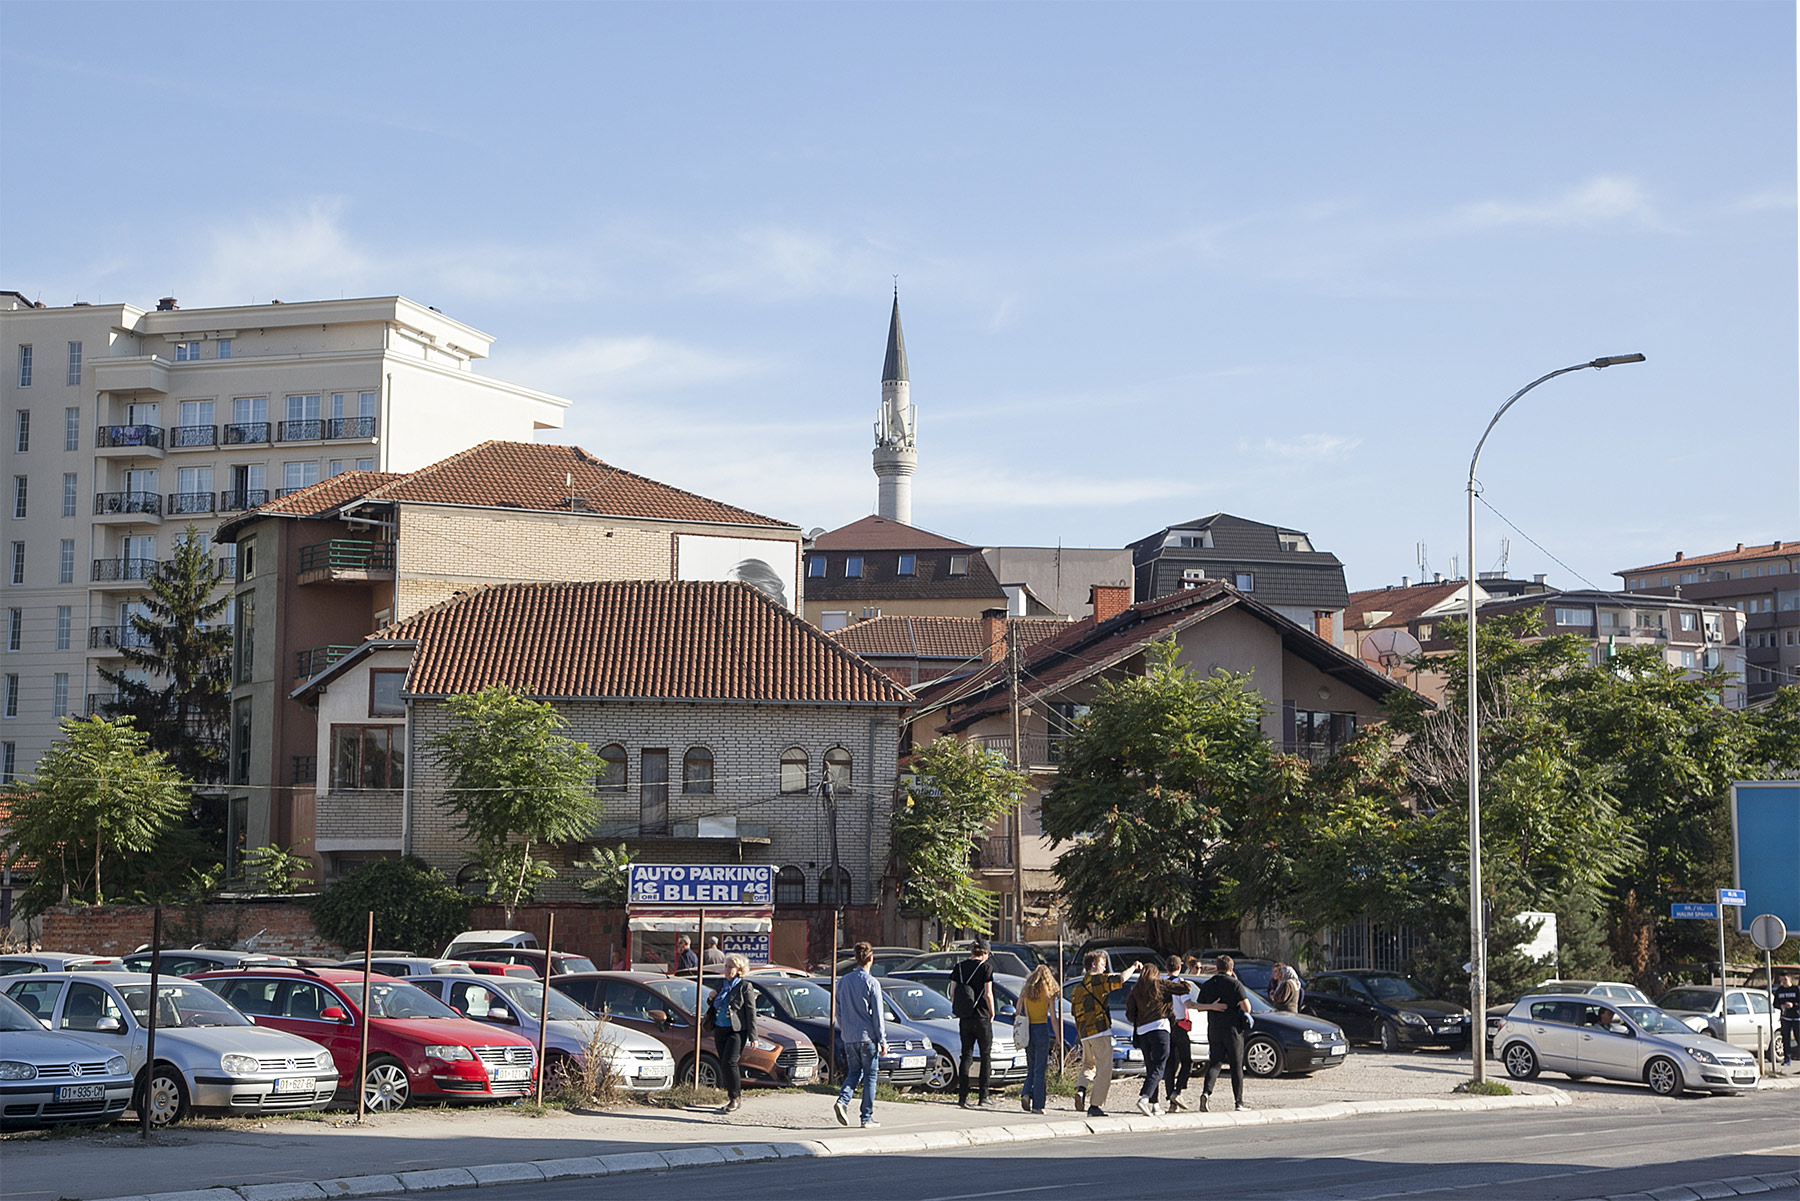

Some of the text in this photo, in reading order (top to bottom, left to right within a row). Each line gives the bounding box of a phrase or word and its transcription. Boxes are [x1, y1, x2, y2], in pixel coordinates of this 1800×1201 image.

[635, 867, 769, 880] AUTO PARKING
[633, 882, 658, 893] 1€
[664, 885, 738, 900] BLERI
[743, 882, 768, 894] 4€
[724, 935, 768, 943] AUTO
